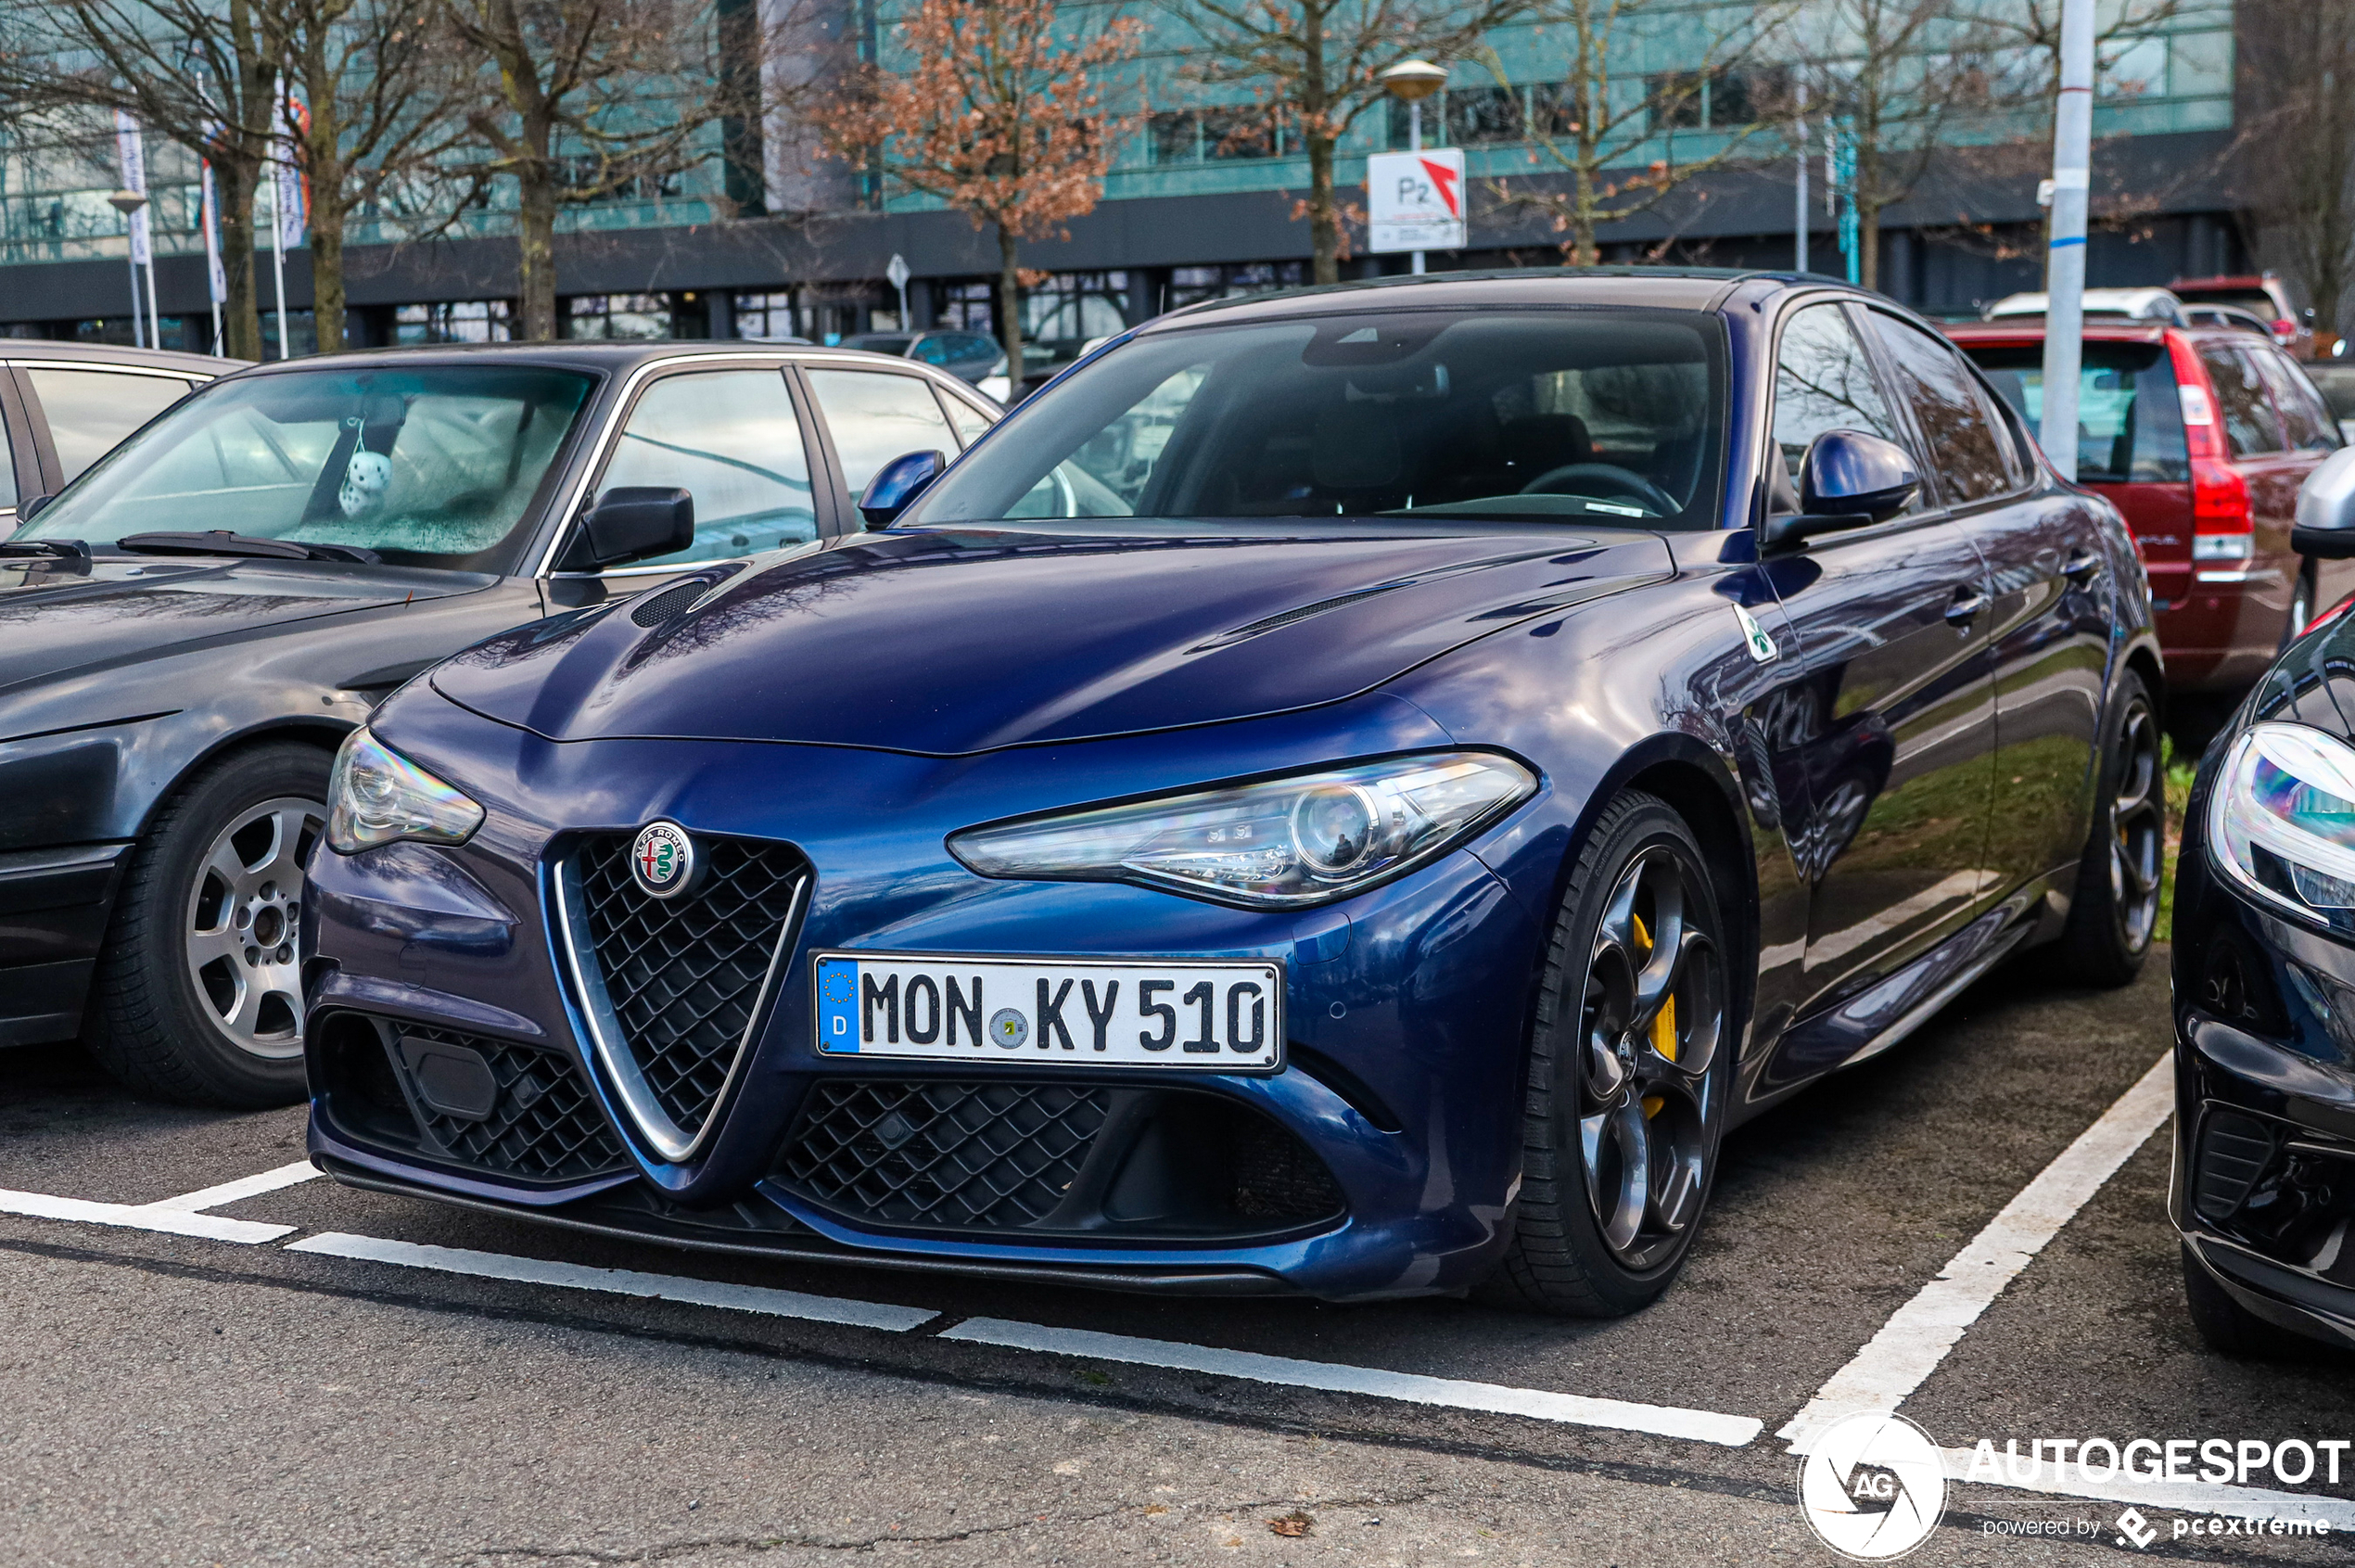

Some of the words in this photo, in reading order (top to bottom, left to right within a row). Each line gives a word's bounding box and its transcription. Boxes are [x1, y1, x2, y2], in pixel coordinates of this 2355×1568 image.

[1397, 176, 1430, 204] P2
[636, 832, 654, 860] ALFA
[656, 829, 685, 862] ROMEO
[833, 1015, 847, 1035] D
[861, 972, 983, 1046] MON
[1036, 977, 1120, 1052] KY
[1139, 979, 1267, 1053] 510
